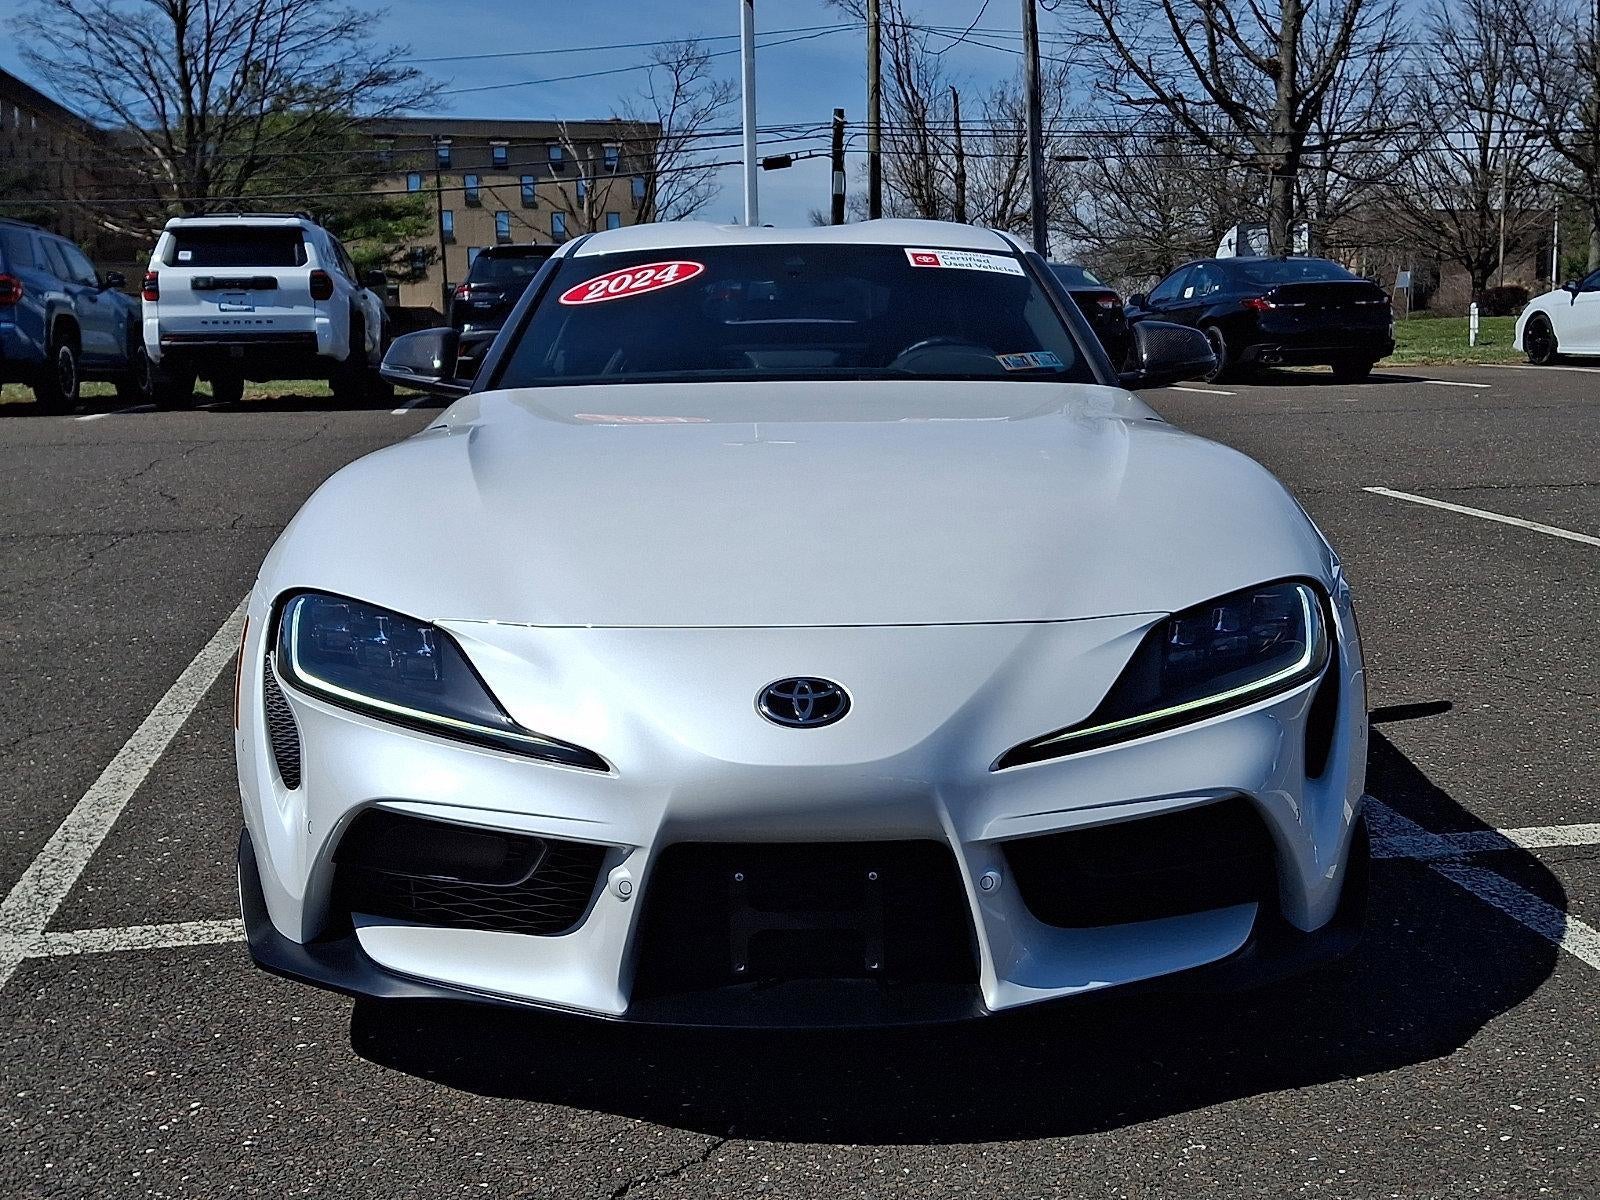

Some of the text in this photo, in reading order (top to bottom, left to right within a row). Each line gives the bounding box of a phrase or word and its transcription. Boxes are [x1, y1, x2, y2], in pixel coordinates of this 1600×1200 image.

[942, 255, 990, 264] Certified
[975, 263, 1020, 274] Vehicles
[582, 264, 679, 301] 2024
